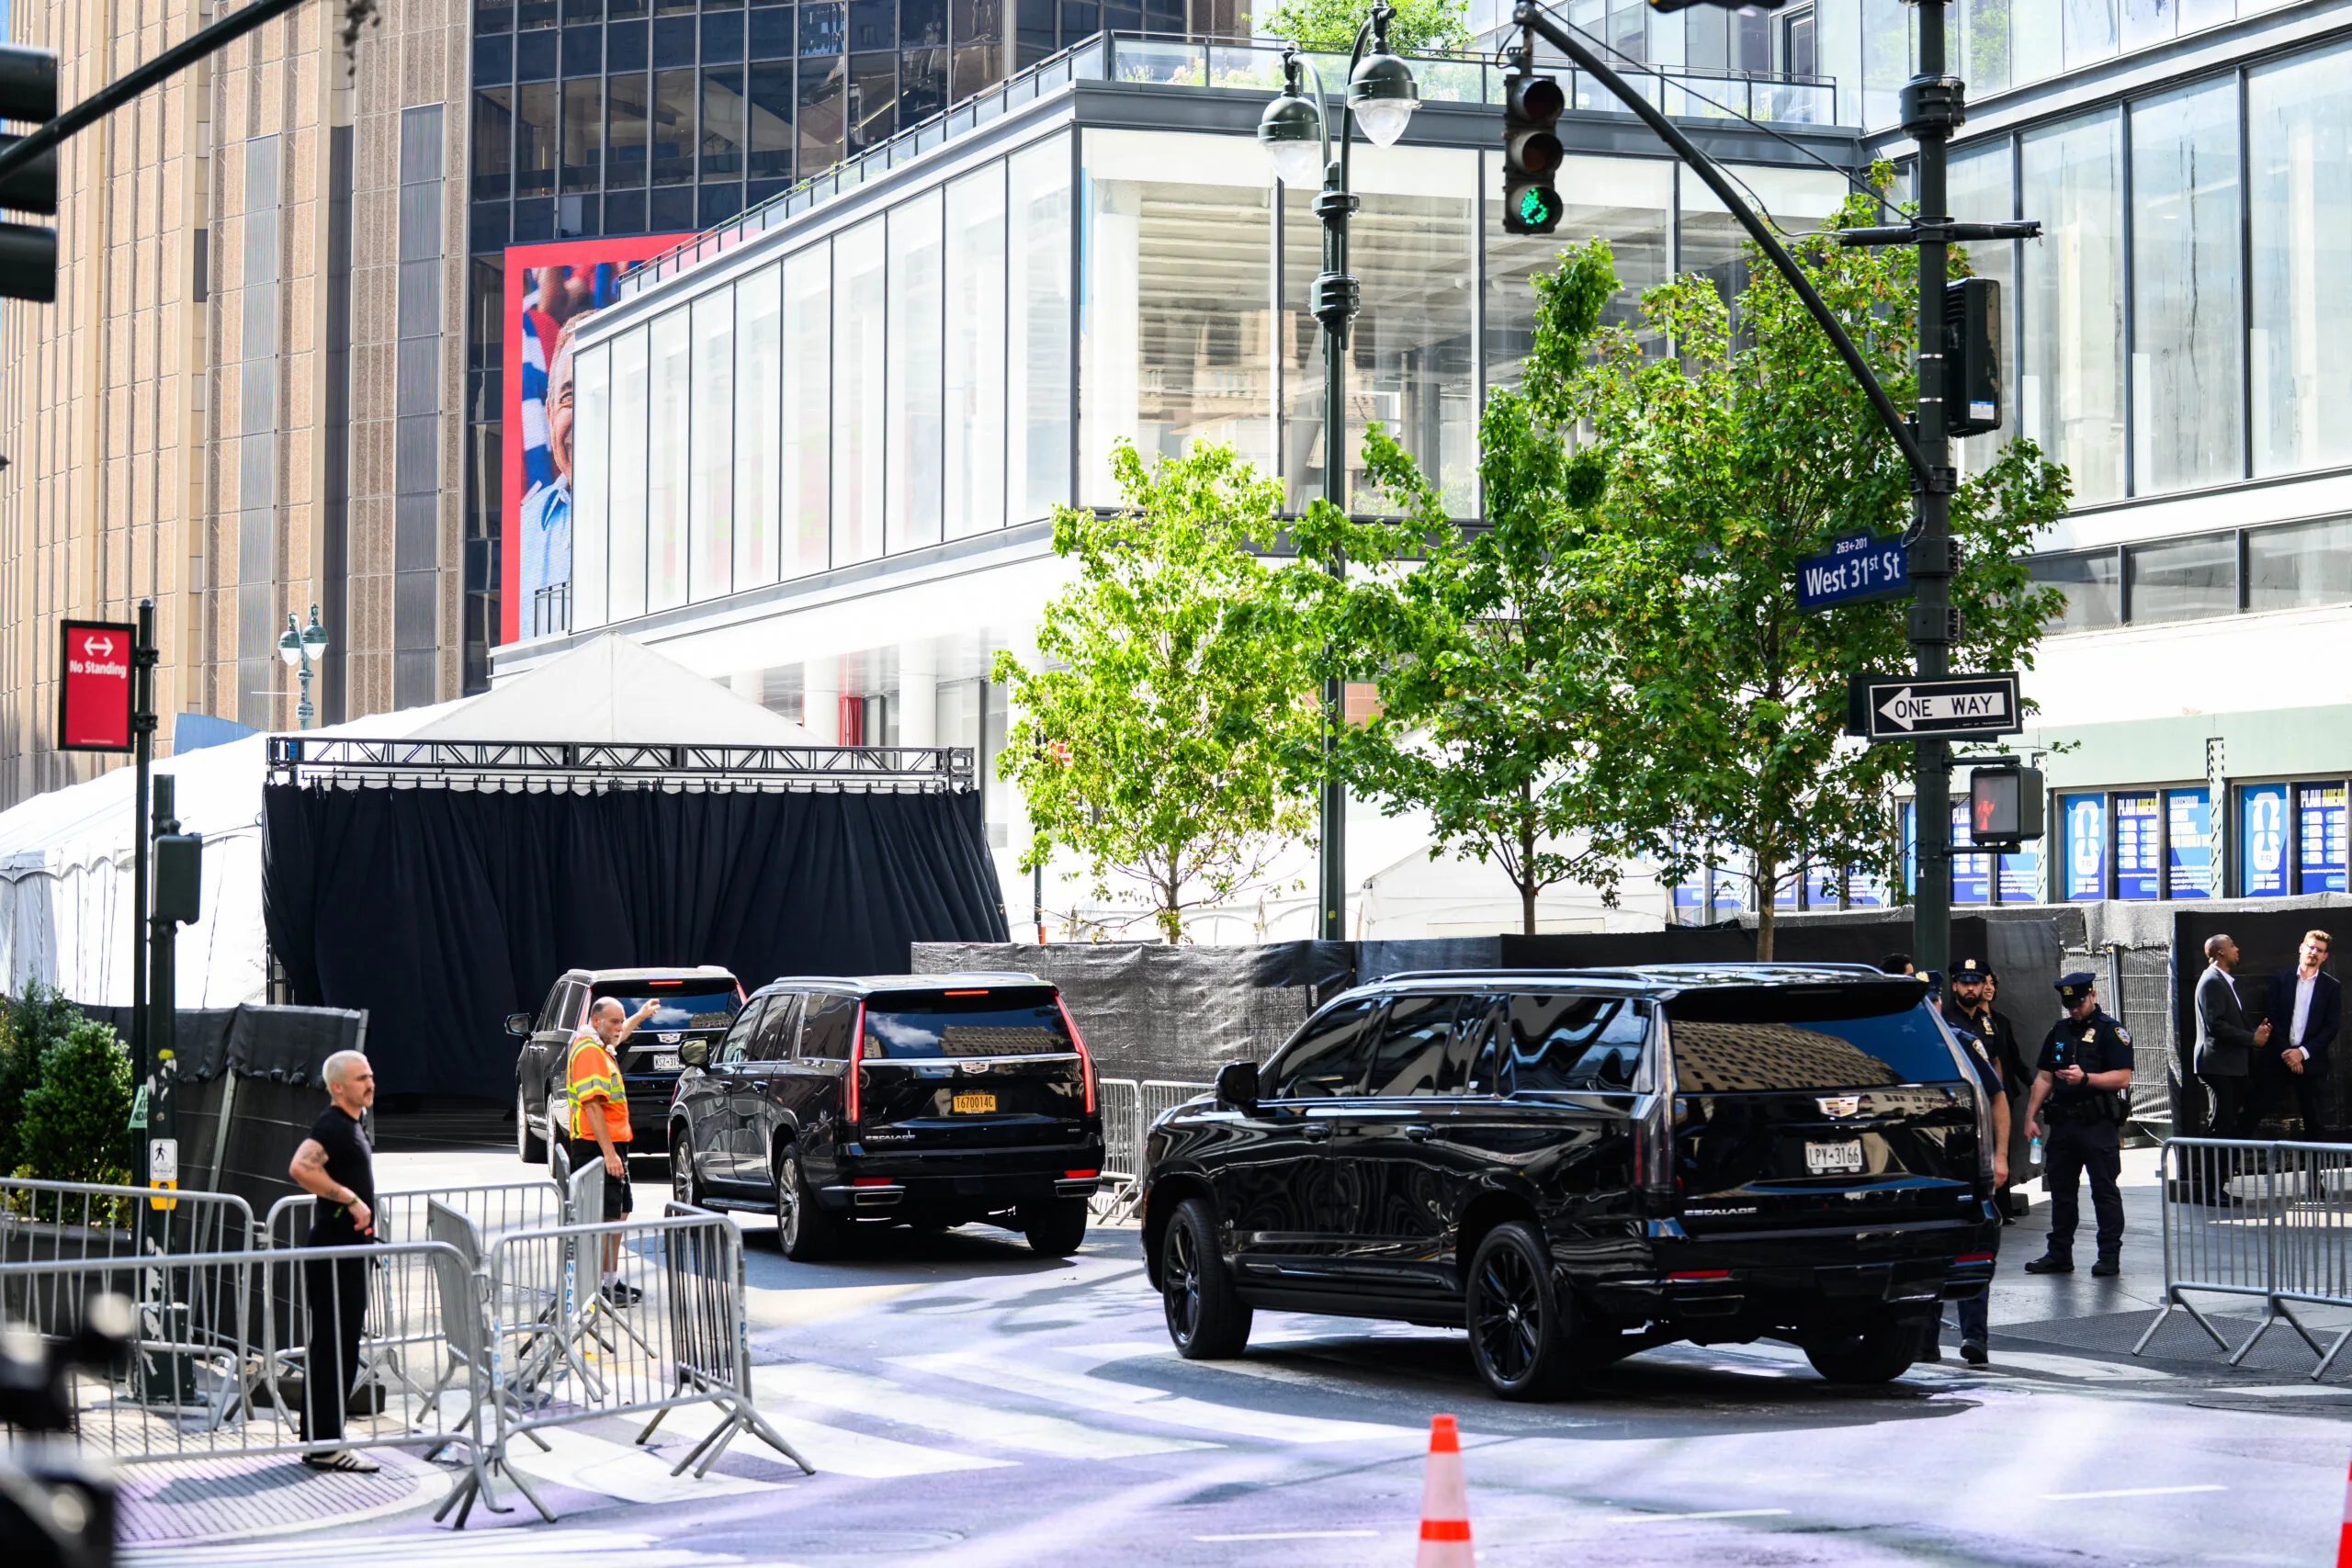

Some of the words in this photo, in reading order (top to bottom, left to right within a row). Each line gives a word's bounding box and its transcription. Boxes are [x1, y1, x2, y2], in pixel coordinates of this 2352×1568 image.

[1836, 541, 1849, 554] 263
[1855, 536, 1868, 549] 201
[1805, 564, 1847, 597] West
[1850, 554, 1879, 588] 31st
[1883, 551, 1901, 581] St
[69, 660, 84, 673] No
[85, 660, 127, 679] Standing
[1894, 699, 1933, 718] ONE
[1951, 695, 1993, 715] WAY
[956, 1096, 993, 1109] T670014C
[1684, 1207, 1757, 1216] ESCALADE
[566, 1262, 574, 1314] NYPD
